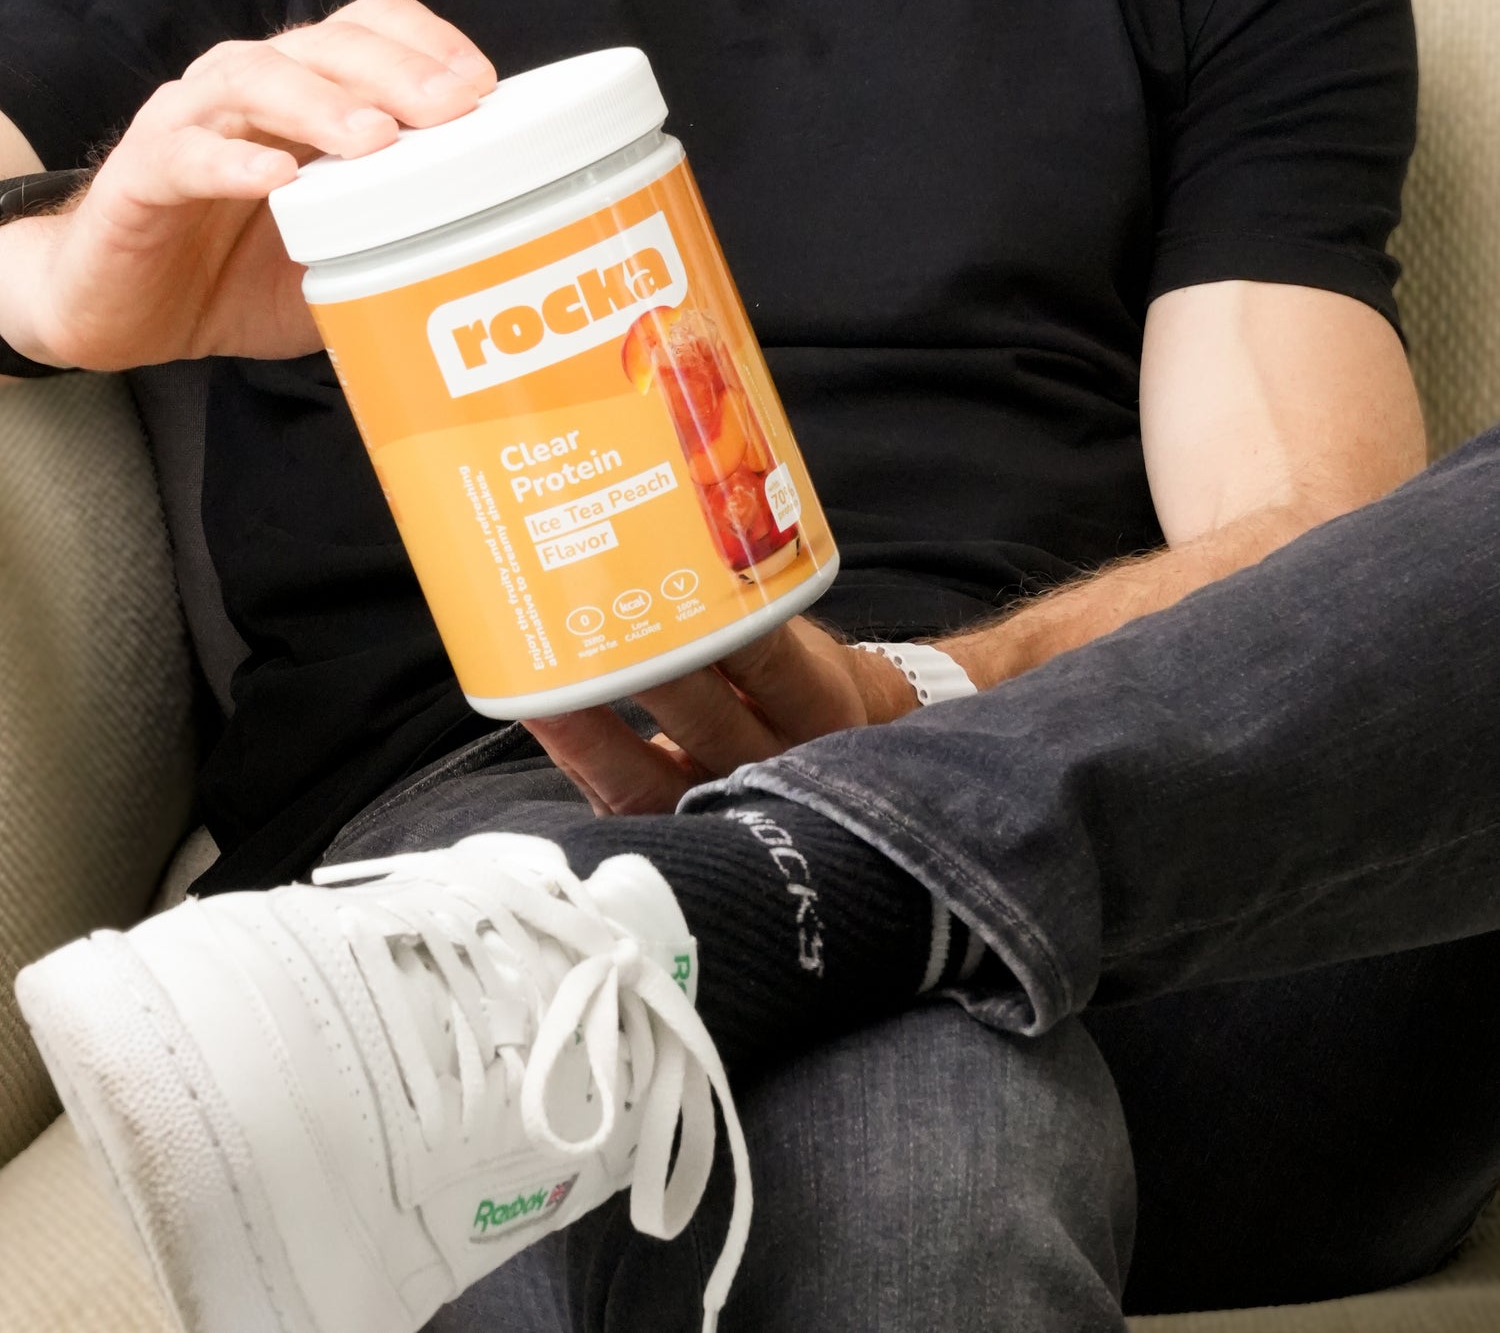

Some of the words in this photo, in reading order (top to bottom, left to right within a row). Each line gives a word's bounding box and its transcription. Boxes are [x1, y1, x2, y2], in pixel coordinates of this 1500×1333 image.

[451, 247, 673, 370] rocka
[500, 430, 580, 472] Clear
[510, 449, 623, 504] Protein
[459, 464, 492, 536] refreshing
[531, 515, 561, 537] Ice
[564, 501, 604, 524] Tea
[608, 472, 671, 508] Peach
[485, 538, 503, 564] and
[496, 524, 521, 573] creamy
[542, 531, 610, 565] Flavor
[499, 567, 519, 605] fruity
[516, 576, 528, 592] to
[619, 595, 646, 613] kcal
[515, 607, 529, 631] the
[523, 593, 558, 667] alternative
[675, 604, 706, 623] VEGAN
[525, 632, 545, 671] Enjoy
[473, 1187, 548, 1233] Reebok
